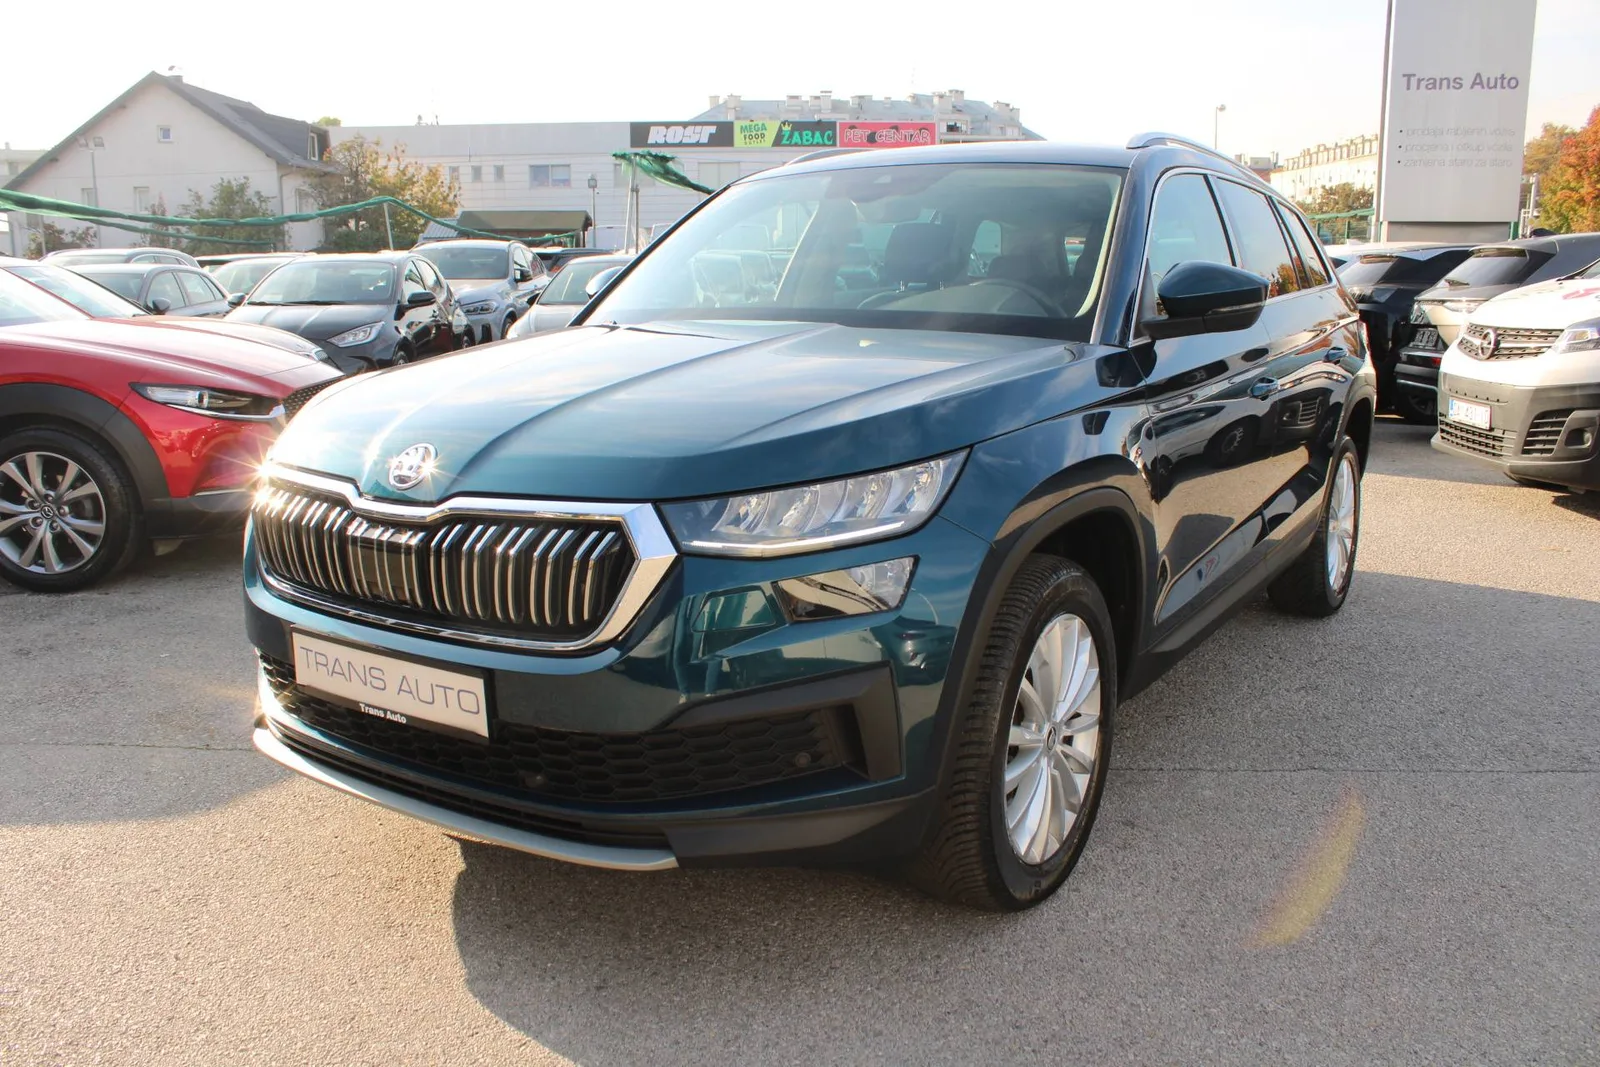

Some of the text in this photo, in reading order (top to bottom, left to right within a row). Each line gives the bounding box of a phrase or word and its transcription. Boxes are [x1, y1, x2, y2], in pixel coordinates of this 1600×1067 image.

[1402, 72, 1519, 91] Trans Auto
[740, 123, 767, 134] MEGA
[743, 132, 766, 141] FOOD
[844, 128, 931, 144] PET CENTAR
[300, 646, 480, 715] TRANS AUTO
[359, 702, 407, 724] Trans Auto
